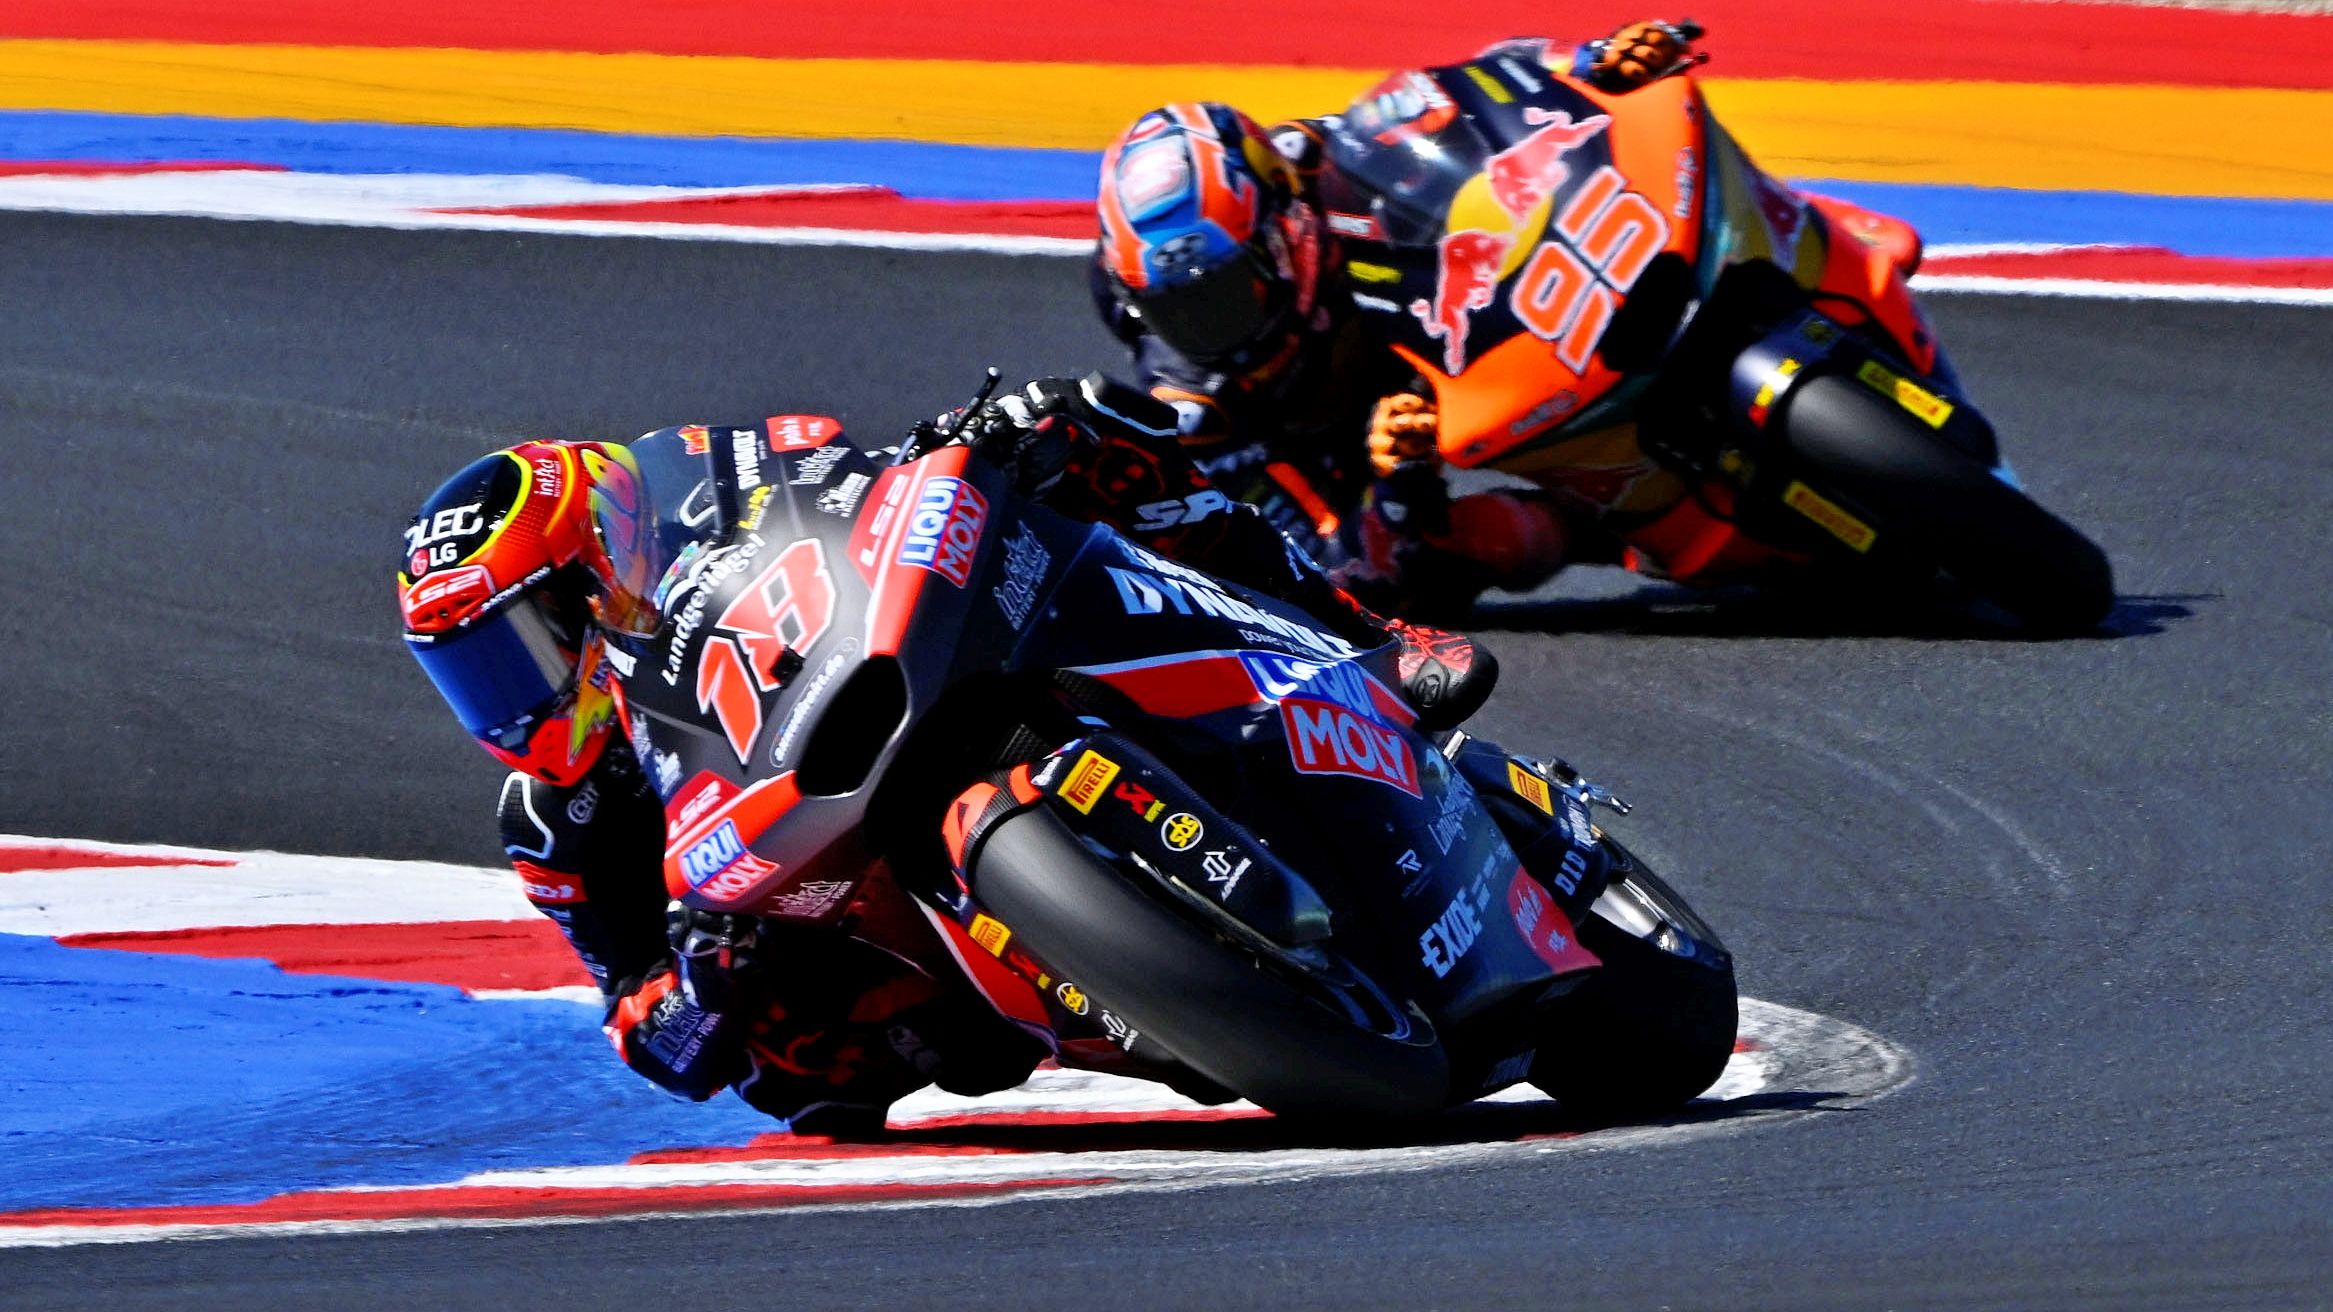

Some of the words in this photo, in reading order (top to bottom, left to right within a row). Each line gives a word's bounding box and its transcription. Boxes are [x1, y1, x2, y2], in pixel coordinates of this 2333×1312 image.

[1510, 165, 1670, 375] 95
[429, 542, 458, 567] LG
[859, 474, 911, 568] LS2
[902, 477, 960, 563] LIQUI
[936, 487, 986, 581] MOLY
[404, 570, 482, 614] LS2
[1104, 565, 1355, 661] DYNAVOLT
[695, 538, 836, 766] 18
[1065, 757, 1111, 807] PIRELLI
[1290, 705, 1410, 786] MOLY
[669, 780, 722, 840] LS2
[682, 820, 742, 886] LIQUI
[702, 855, 770, 899] MOLY
[1418, 891, 1484, 979] EXIDE
